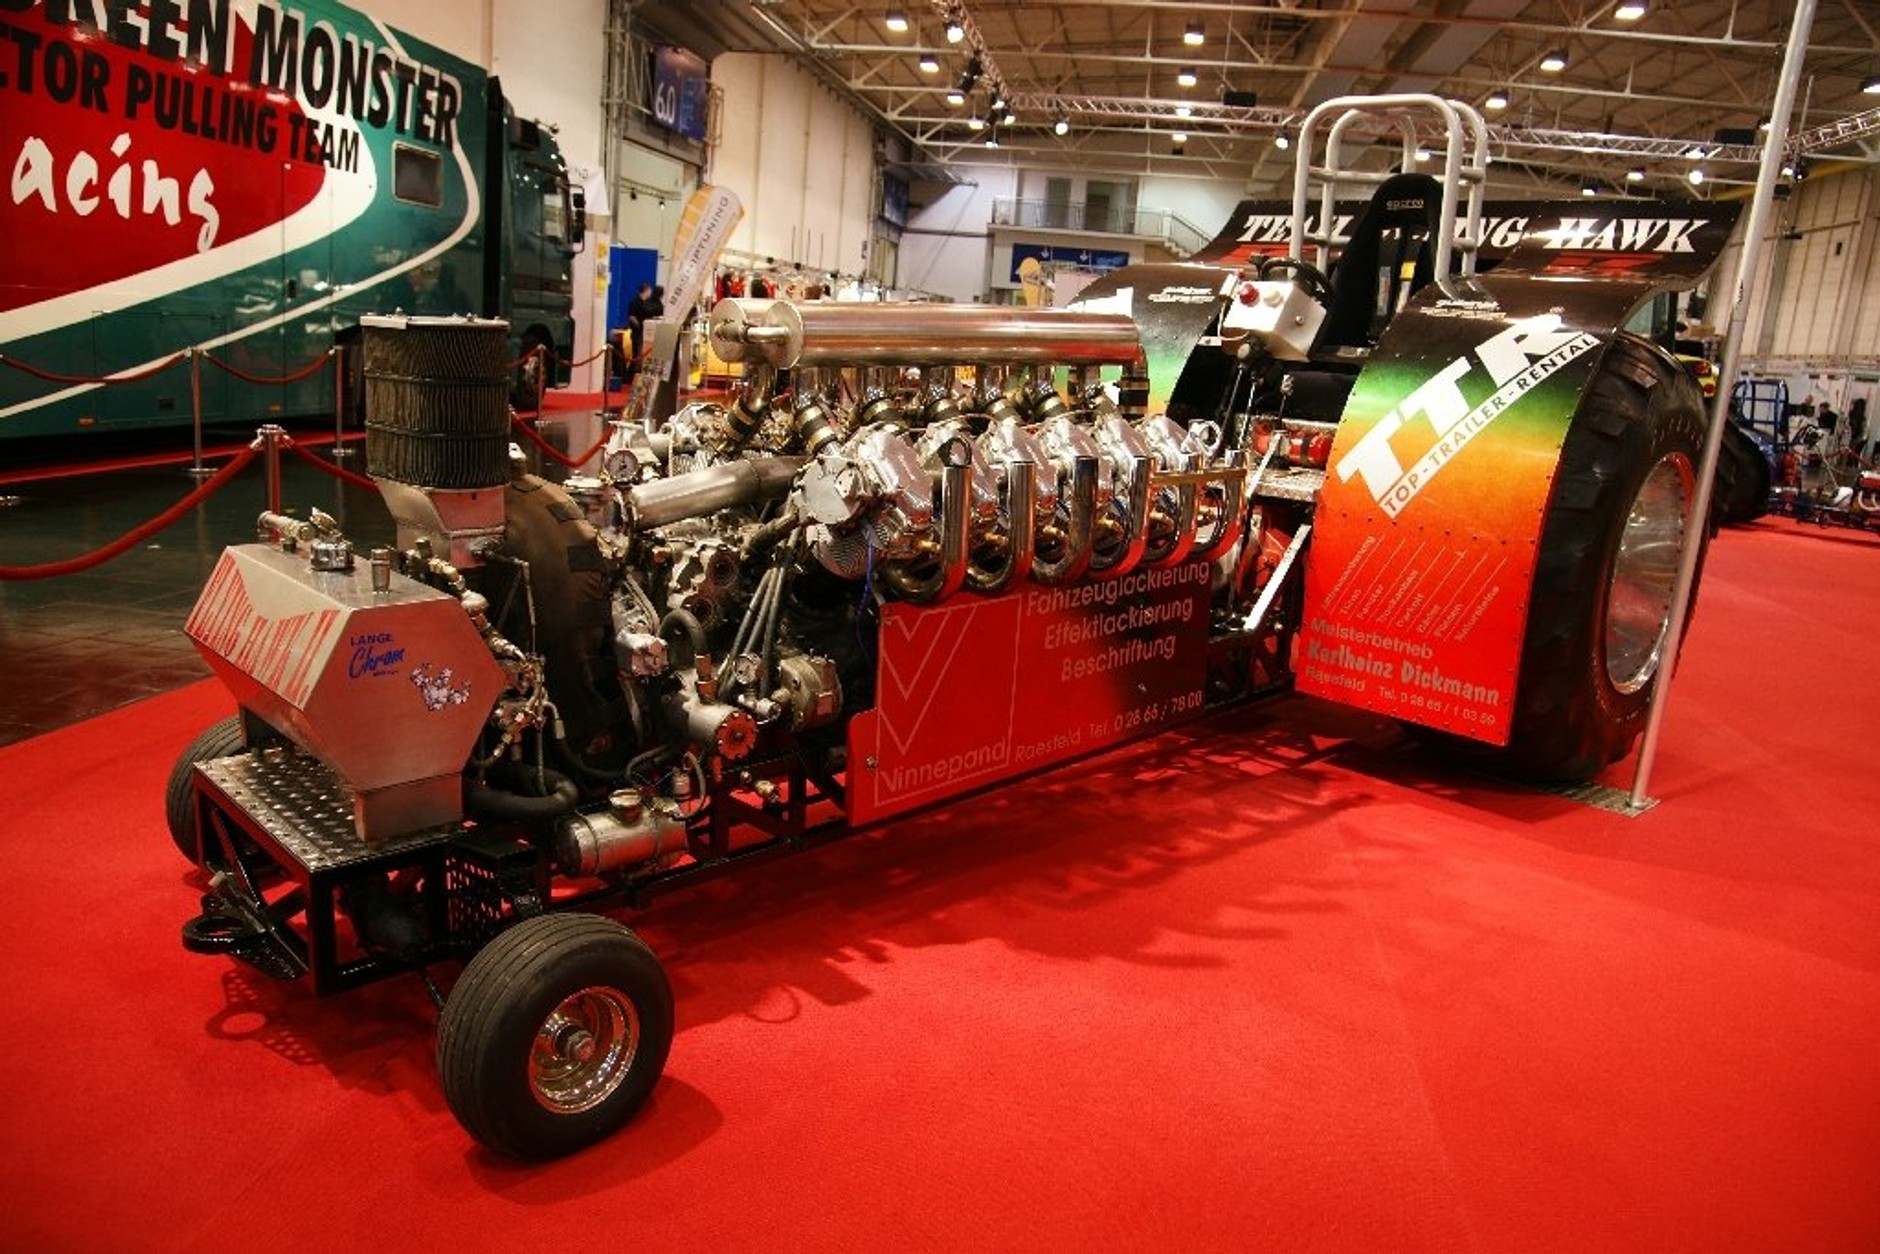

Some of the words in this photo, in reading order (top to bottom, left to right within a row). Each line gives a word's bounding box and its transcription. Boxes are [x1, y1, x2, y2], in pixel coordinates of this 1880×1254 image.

[0, 23, 110, 113] TOR
[125, 63, 278, 154] PULLING
[287, 114, 360, 174] TEAM
[250, 4, 460, 150] MONSTER
[1543, 217, 1710, 253] HAWK
[1335, 313, 1584, 505] TTR
[1027, 561, 1210, 616] Fahrzeuglackierung
[350, 633, 392, 646] LANGE
[1045, 596, 1193, 649] Effektlackierung
[1311, 617, 1433, 660] Meisterbetrieb
[1061, 635, 1177, 682] Beschriftung
[1308, 640, 1394, 679] Karlheinz
[1401, 661, 1500, 706] Dickmann
[880, 736, 1006, 793] Vinnepand
[1015, 727, 1081, 763] Raesfeld
